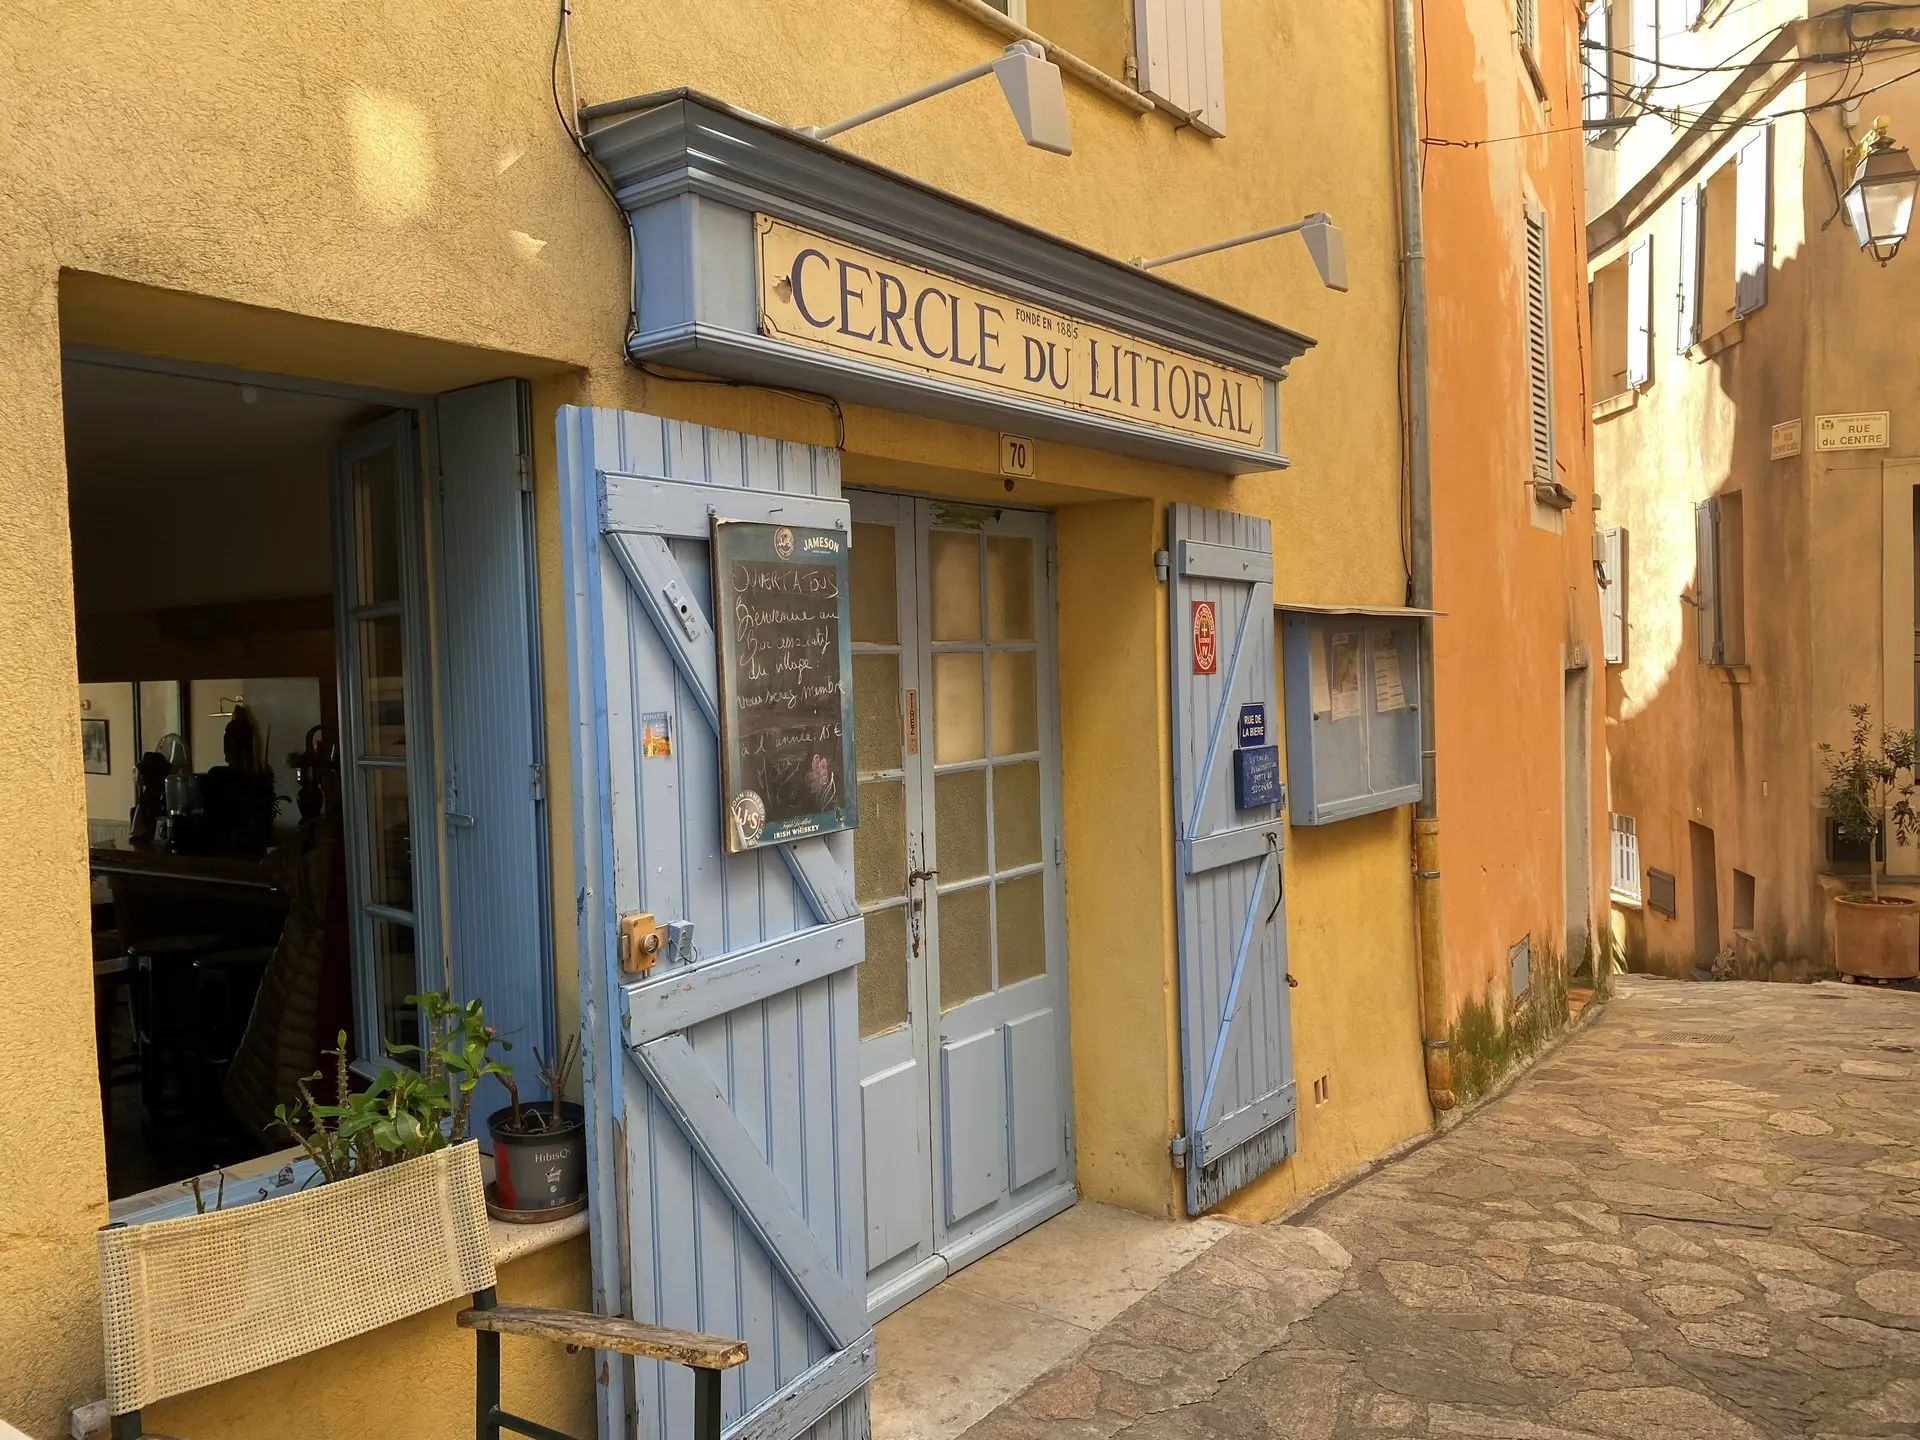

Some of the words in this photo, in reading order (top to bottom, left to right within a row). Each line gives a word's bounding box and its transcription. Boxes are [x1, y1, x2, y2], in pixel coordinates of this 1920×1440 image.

[1042, 316, 1053, 331] EN
[1056, 320, 1079, 339] 1885
[790, 247, 1006, 375] CERCLE
[1021, 334, 1071, 391] DU
[1087, 337, 1254, 435] LITTORAL
[1848, 423, 1871, 434] RUE
[1822, 437, 1835, 446] du
[1840, 434, 1883, 446] CENTRE
[1009, 442, 1027, 470] 70
[803, 536, 840, 554] JAMESON
[730, 563, 791, 593] OUVERT
[802, 570, 839, 599] TOUS
[748, 657, 769, 680] du
[775, 651, 813, 684] village
[1243, 715, 1255, 725] RUE
[1255, 714, 1262, 724] DE
[1242, 728, 1250, 737] LA
[1249, 726, 1264, 737] BIERE
[773, 829, 791, 840] IRISH
[792, 823, 820, 836] WHISKEY
